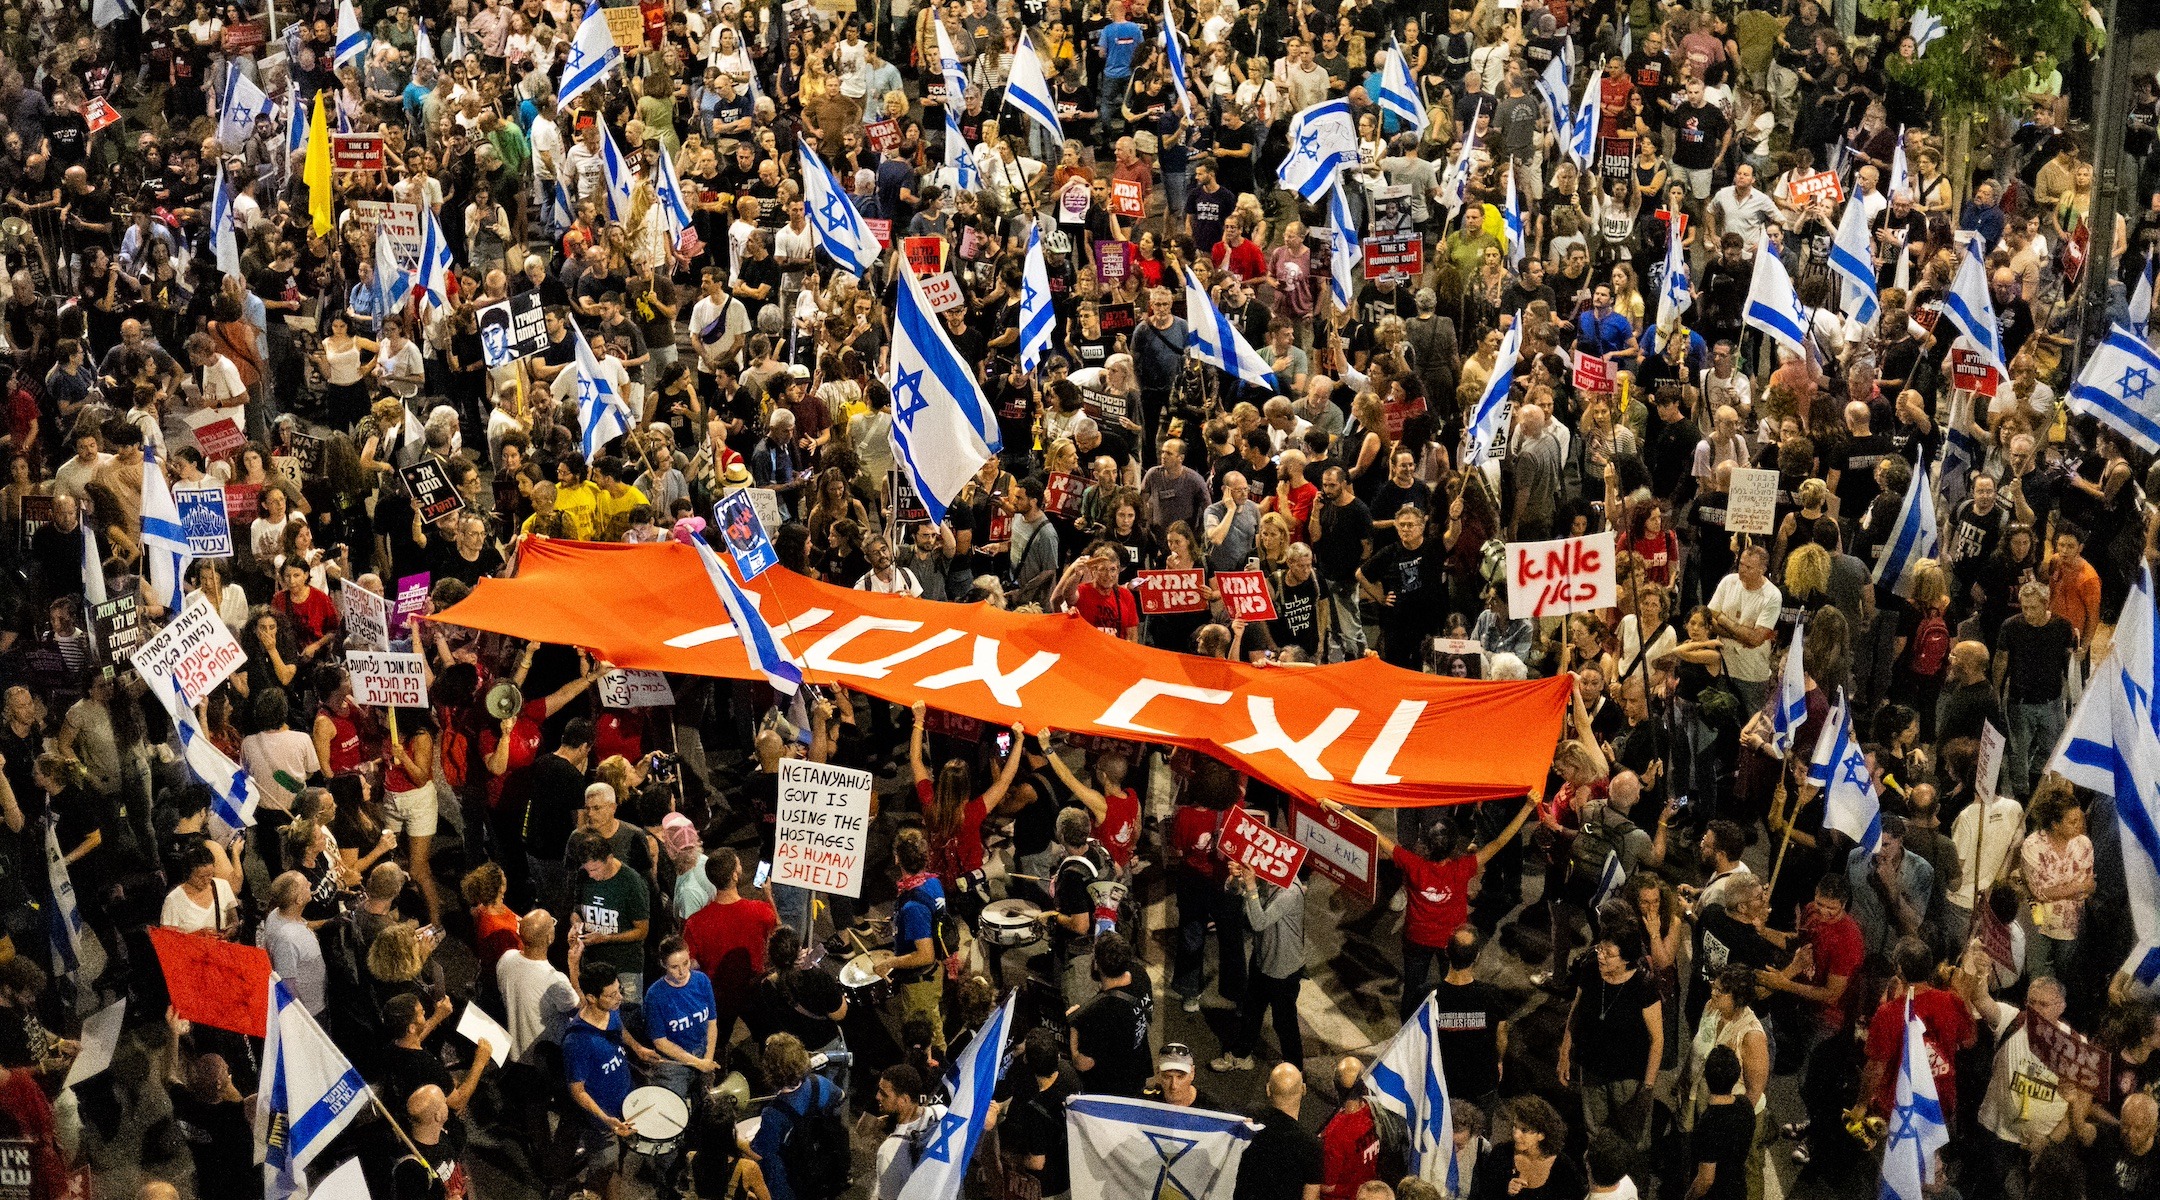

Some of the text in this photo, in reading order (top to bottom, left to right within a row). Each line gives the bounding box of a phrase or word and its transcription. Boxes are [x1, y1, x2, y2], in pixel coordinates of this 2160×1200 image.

[869, 122, 896, 137] אמא
[348, 142, 362, 150] TIME
[880, 134, 900, 148] כאן
[338, 150, 379, 159] RUNNING OUT!
[1605, 155, 1629, 167] העם
[1114, 183, 1138, 198] אמא
[1795, 174, 1835, 195] אמא
[1120, 198, 1140, 212] כאן
[1370, 251, 1417, 265] RUNNING OUT!
[922, 280, 950, 298] עסק
[1584, 360, 1603, 372] חיים
[1083, 389, 1095, 399] אש
[1095, 394, 1126, 407] הפסקת
[417, 465, 435, 480] אל
[177, 490, 221, 503] בחירות
[422, 493, 434, 506] לו
[190, 538, 225, 552] עכשיו
[1518, 540, 1600, 586] אמא
[1148, 574, 1198, 590] אמא
[1221, 576, 1262, 594] אמא
[1162, 591, 1201, 608] כאן
[1234, 596, 1267, 614] כאן
[1285, 594, 1310, 610] שלום
[1532, 580, 1597, 617] כאן
[126, 611, 136, 626] יש
[1292, 621, 1310, 636] צדק
[664, 580, 1062, 708] אמא
[384, 661, 404, 673] מוכר
[408, 661, 423, 674] הוא
[182, 670, 207, 700] בלהו
[404, 677, 419, 689] הם
[367, 690, 419, 703] בארונות
[1092, 677, 1427, 784] כאן
[782, 764, 871, 790] NETANYAHU'S
[784, 788, 848, 807] GOVT IS
[782, 809, 862, 830] USING THE
[780, 827, 854, 851] HOSTAGES
[1235, 817, 1298, 863] אמא
[778, 842, 856, 870] AS HUMAN
[1241, 844, 1289, 878] כאן
[781, 861, 848, 888] SHIELD
[1464, 1018, 1486, 1028] FORUM
[2036, 1021, 2100, 1070] אמא
[2, 1149, 30, 1168] אין
[0, 1169, 31, 1185] עם
